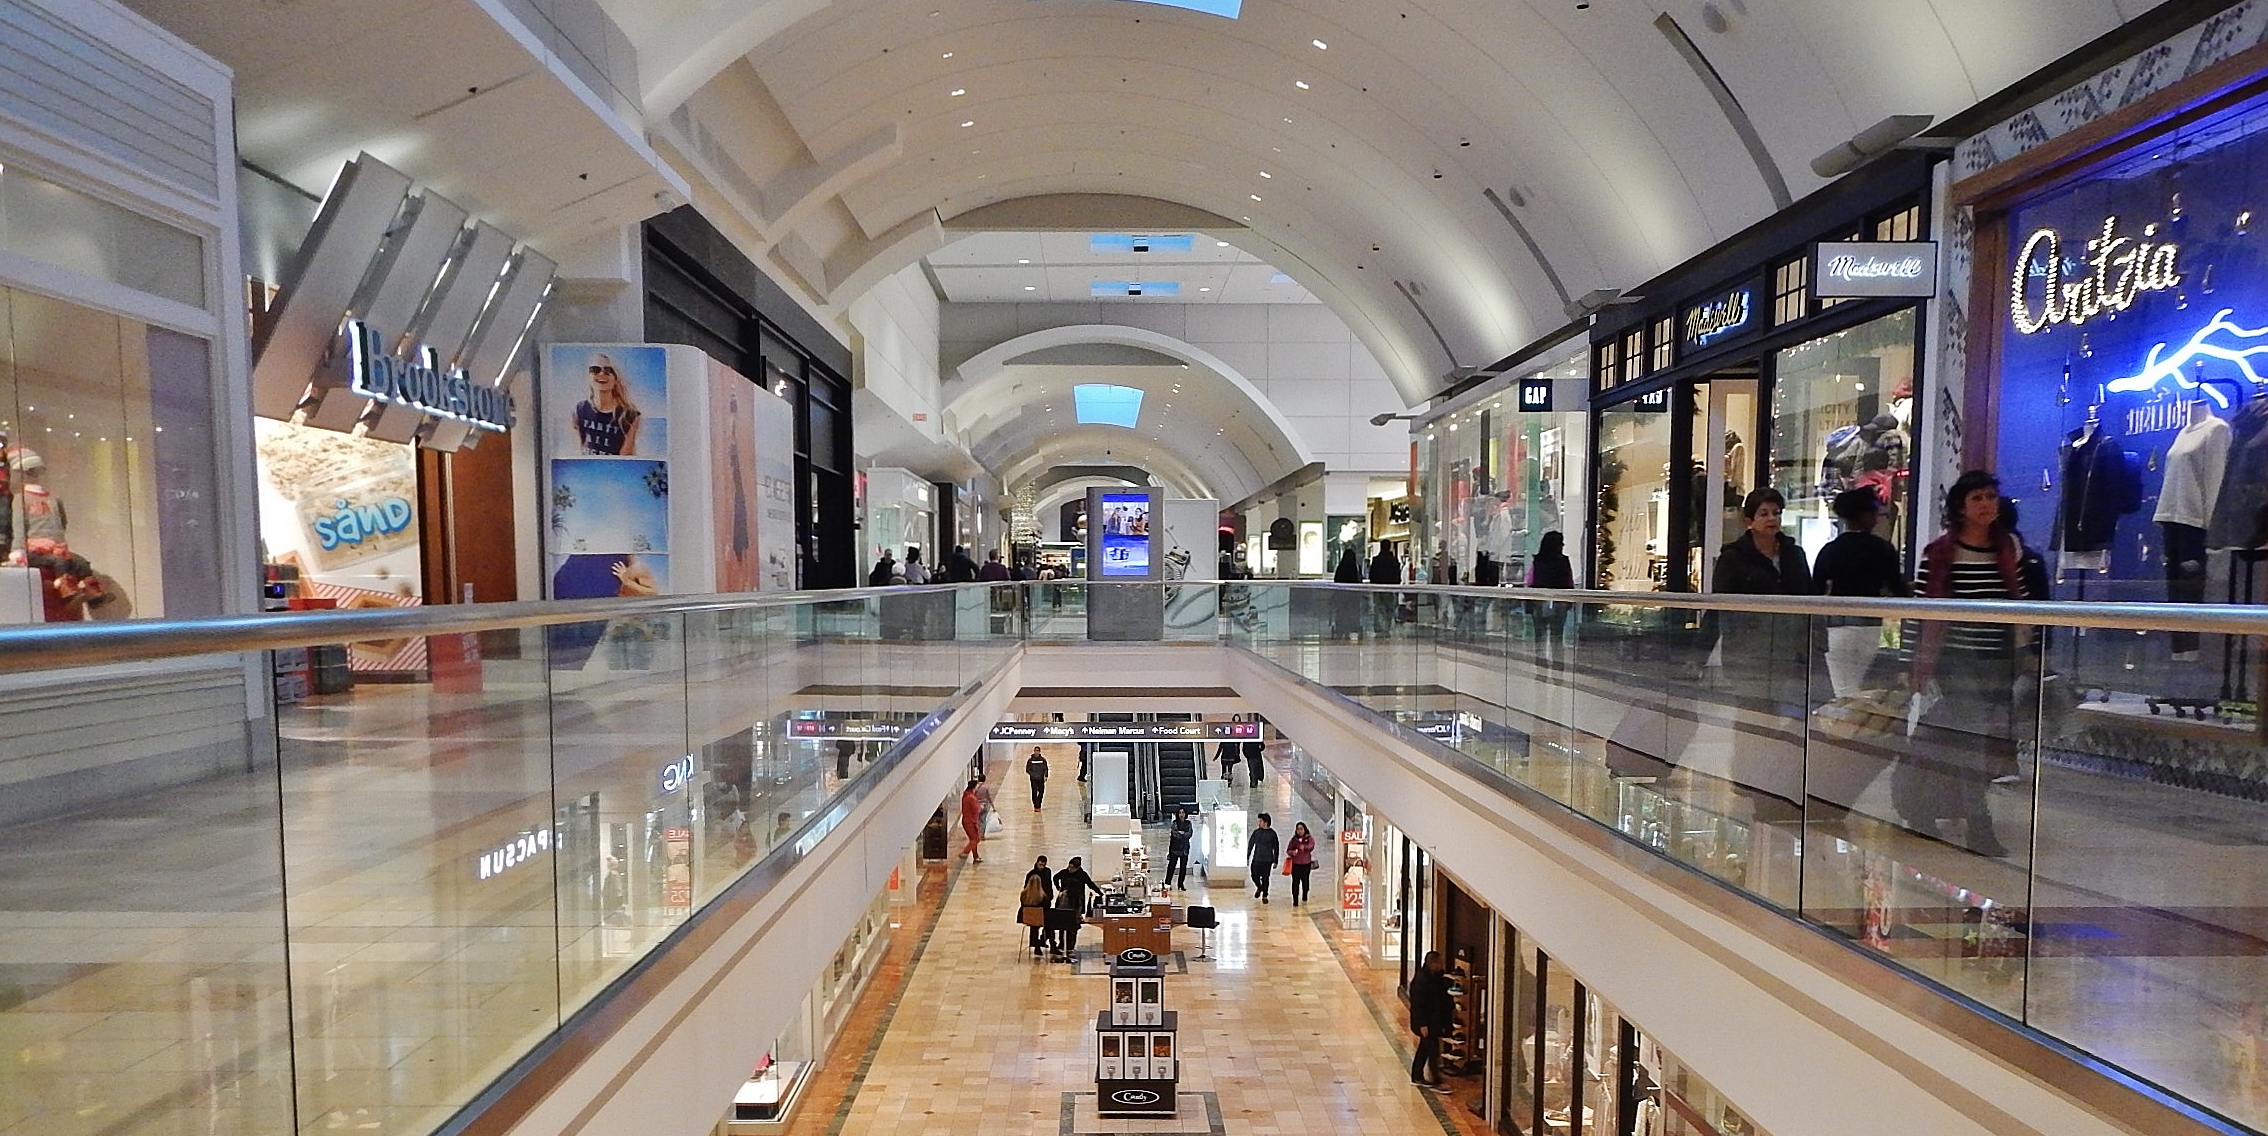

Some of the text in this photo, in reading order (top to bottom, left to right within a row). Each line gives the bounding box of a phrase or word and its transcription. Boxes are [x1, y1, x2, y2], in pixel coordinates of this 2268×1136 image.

[1827, 255, 1922, 281] Madewell
[2011, 215, 2181, 334] Aritzia
[1524, 386, 1548, 405] GAP
[1000, 727, 1201, 737] JCPenney Macy's Neiman Marcus Food Court
